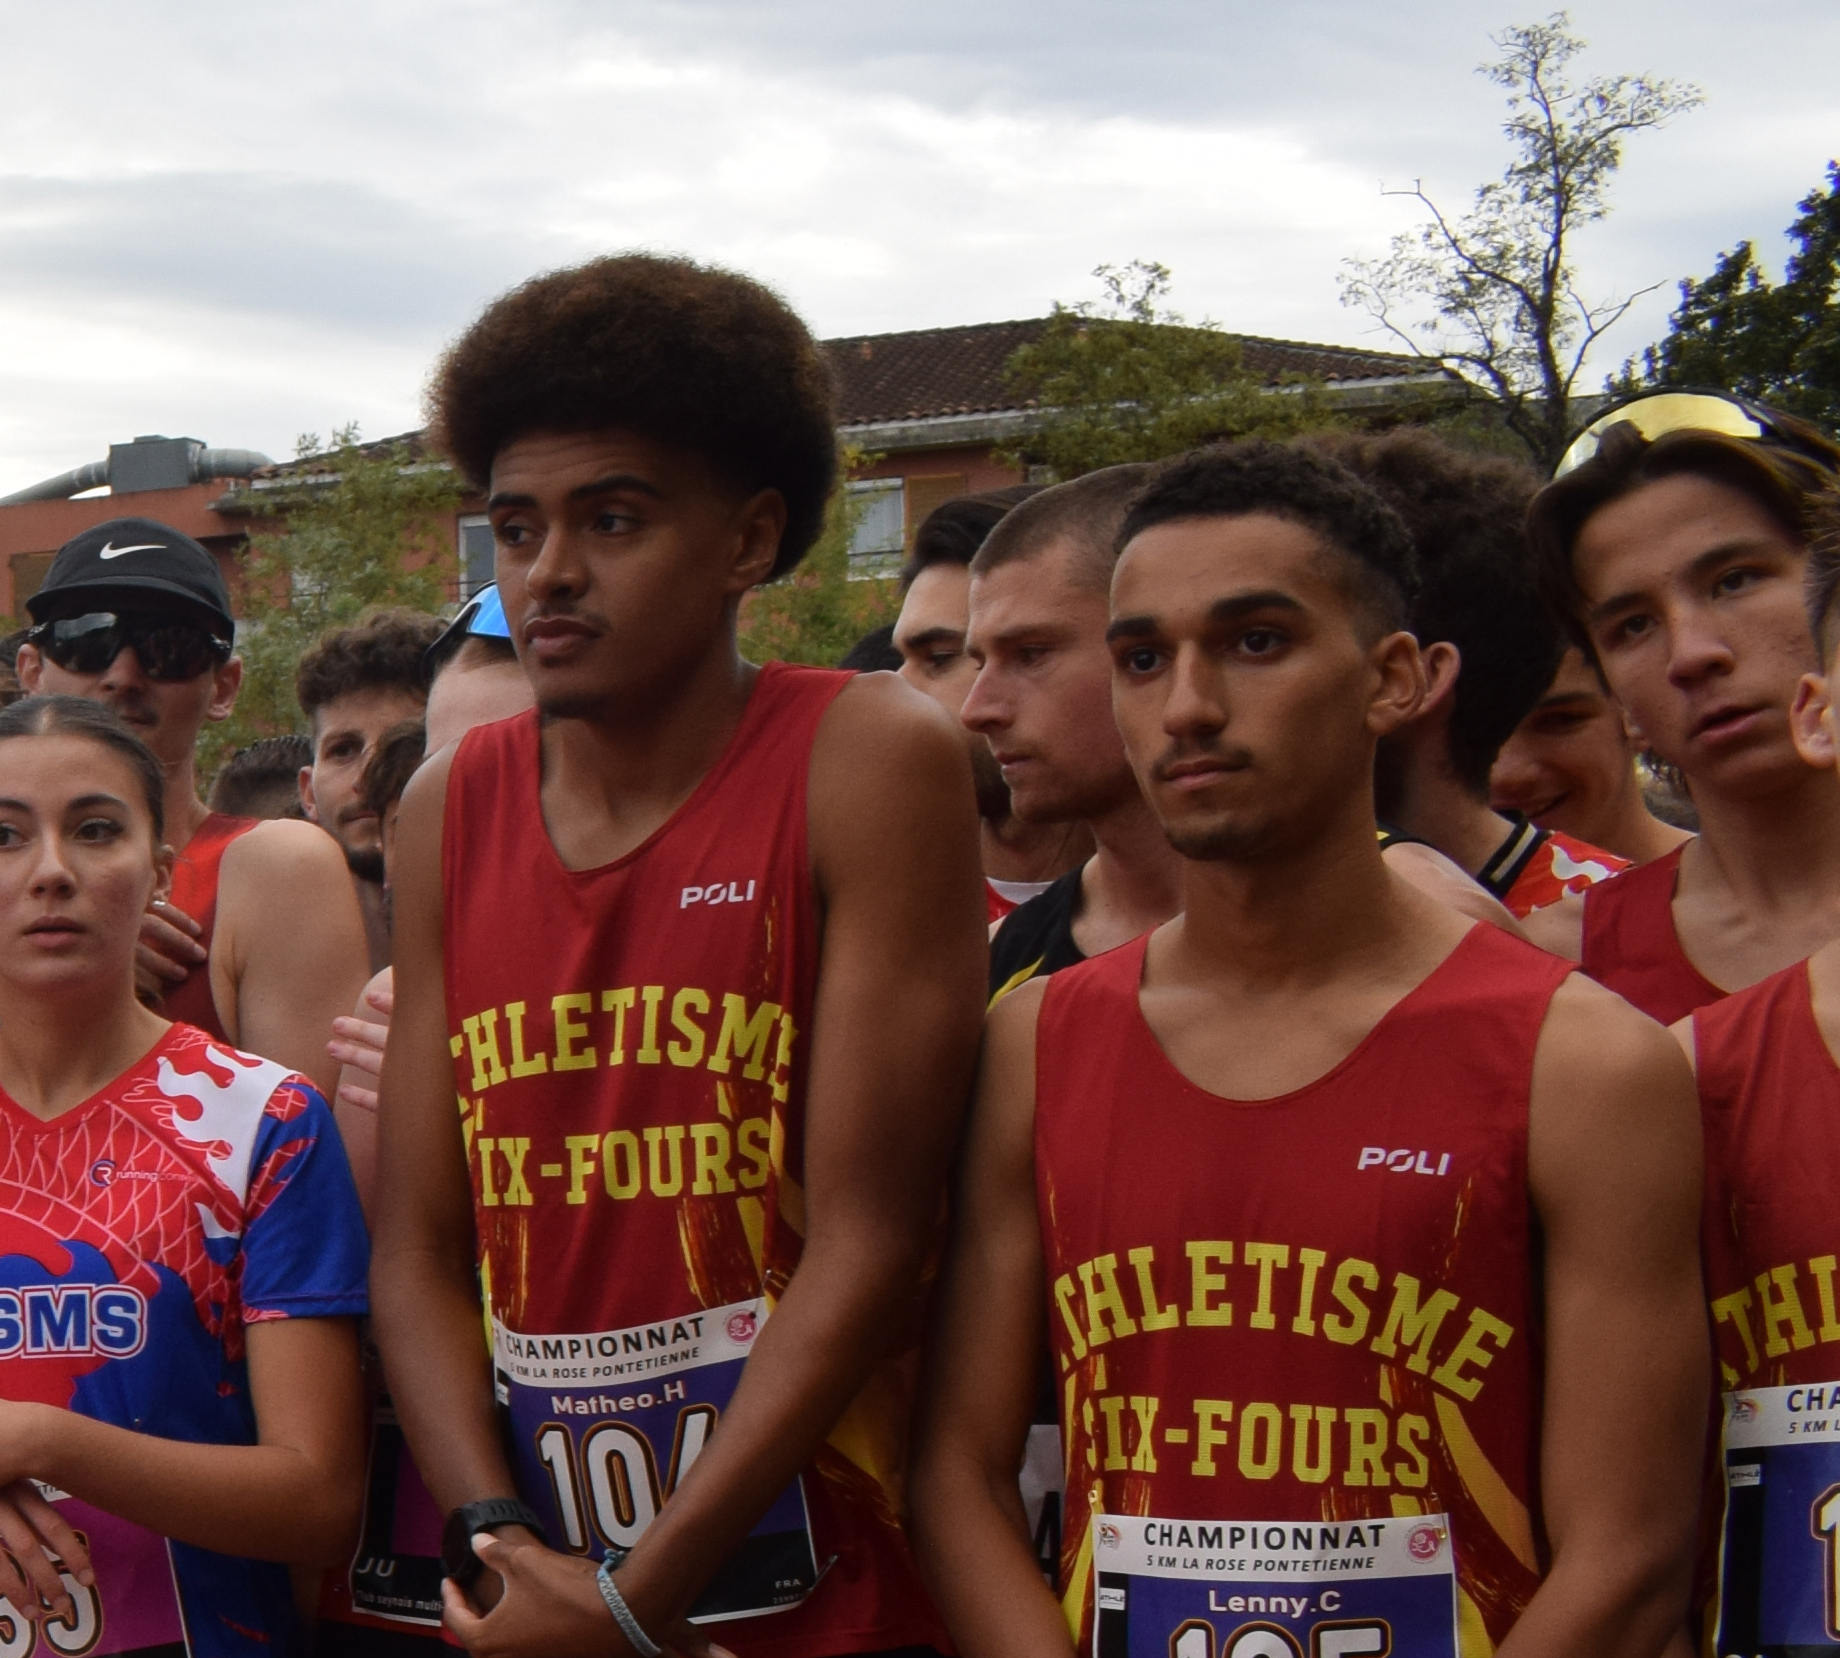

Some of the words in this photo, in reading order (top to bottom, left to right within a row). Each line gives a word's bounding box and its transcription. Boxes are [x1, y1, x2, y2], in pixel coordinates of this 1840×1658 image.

[680, 880, 756, 909] POLI
[1357, 1147, 1451, 1176] POLI
[1054, 1240, 1515, 1401] THLETISME
[505, 1316, 705, 1361] CHAMPIONNAT
[533, 1366, 548, 1379] LA
[552, 1367, 587, 1379] ROSE
[592, 1347, 700, 1378] PONTETIENNE
[551, 1380, 685, 1416] Matheo.H
[1788, 1417, 1797, 1434] 5
[1802, 1416, 1828, 1433] KM
[1143, 1522, 1386, 1551] CHAMPIONNAT
[1146, 1554, 1153, 1567] 5
[1157, 1554, 1177, 1568] KM
[1182, 1556, 1199, 1570] LA
[1205, 1557, 1246, 1572] ROSE
[1253, 1556, 1376, 1572] PONTETIENNE
[1208, 1590, 1342, 1618] Lenny.C
